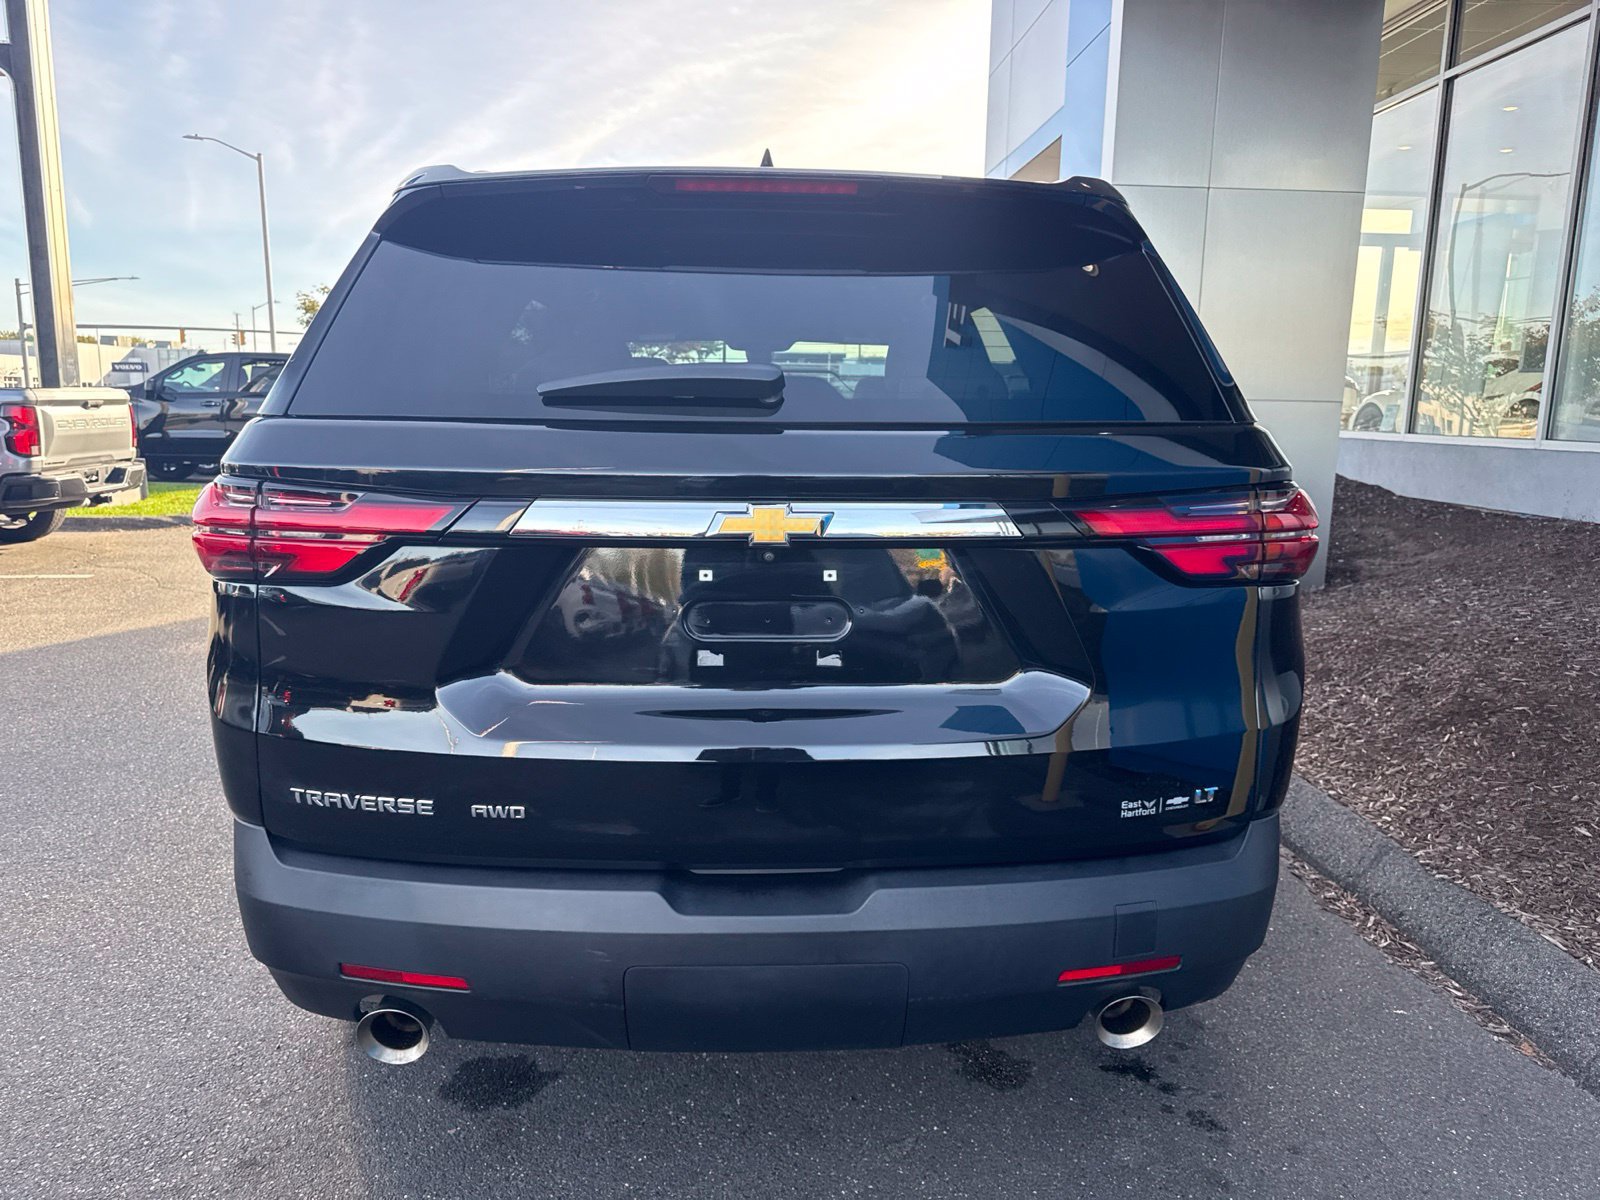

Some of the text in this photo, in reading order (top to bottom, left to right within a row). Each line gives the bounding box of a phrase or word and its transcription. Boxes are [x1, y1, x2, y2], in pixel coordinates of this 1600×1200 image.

[56, 417, 127, 430] CHEVROLET
[290, 787, 434, 815] TRAVERSE
[1194, 787, 1218, 804] LT
[470, 804, 526, 819] AWD
[1121, 800, 1141, 809] East
[1120, 807, 1156, 818] Hartford
